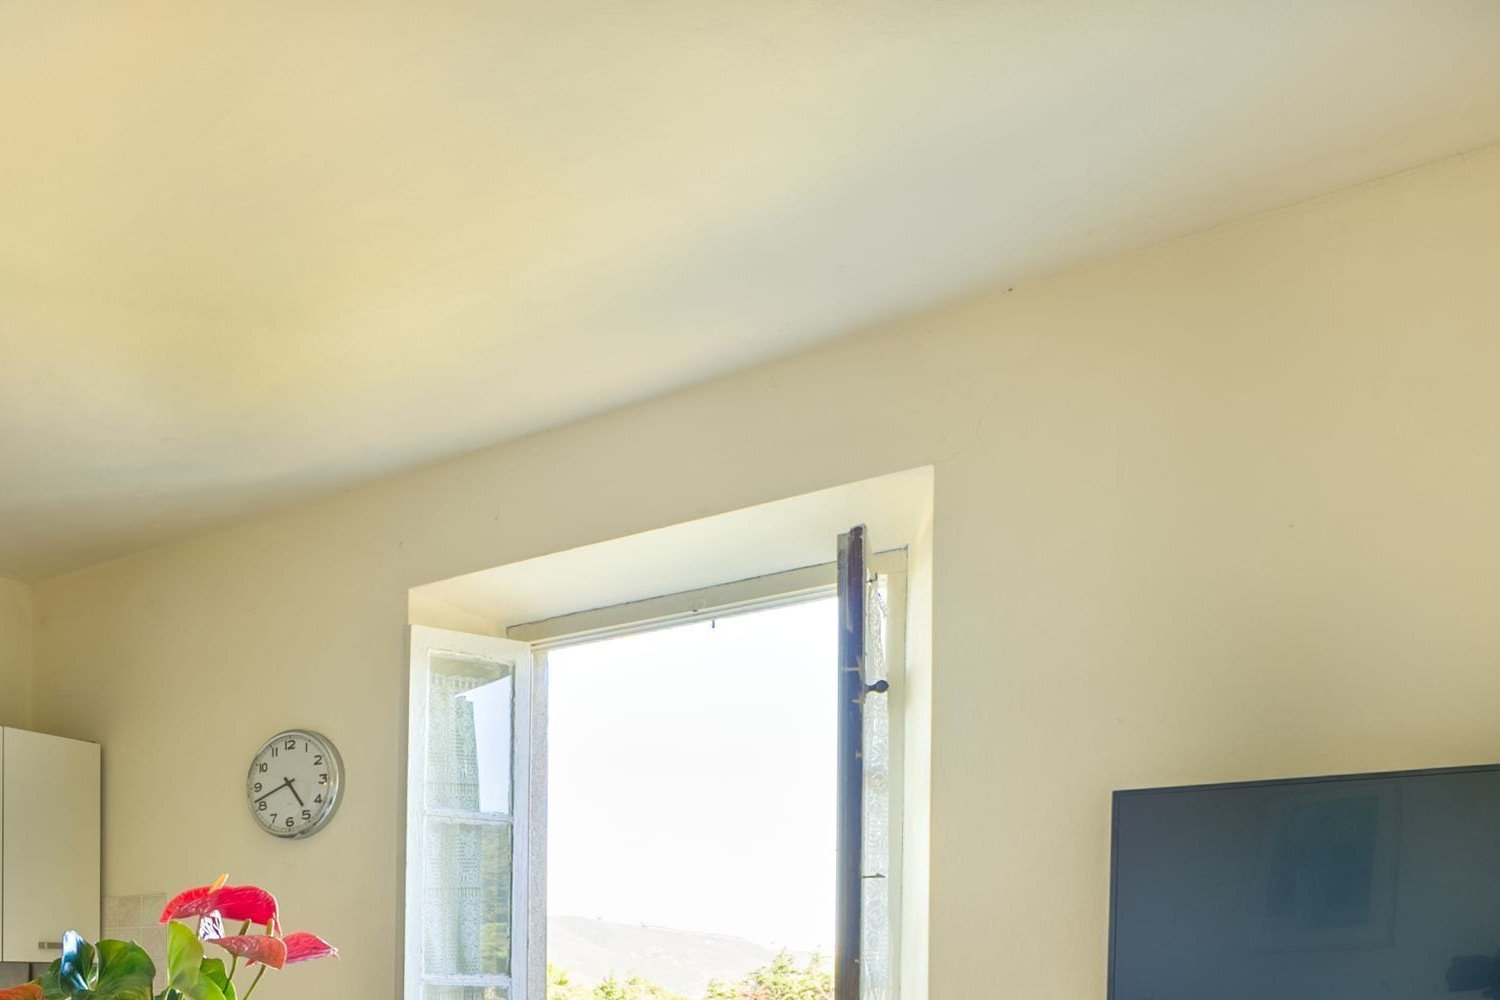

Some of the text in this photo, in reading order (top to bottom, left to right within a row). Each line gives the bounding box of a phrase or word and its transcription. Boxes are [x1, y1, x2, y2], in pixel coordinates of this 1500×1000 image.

[284, 739, 296, 750] 12
[271, 747, 278, 758] 11
[313, 755, 322, 766] 2
[259, 763, 268, 773] 10
[318, 774, 327, 784] 3
[254, 782, 262, 792] 9
[314, 794, 322, 804] 4
[258, 801, 267, 811] 8
[270, 813, 277, 824] 7
[301, 810, 311, 820] 5
[285, 817, 294, 827] 6
